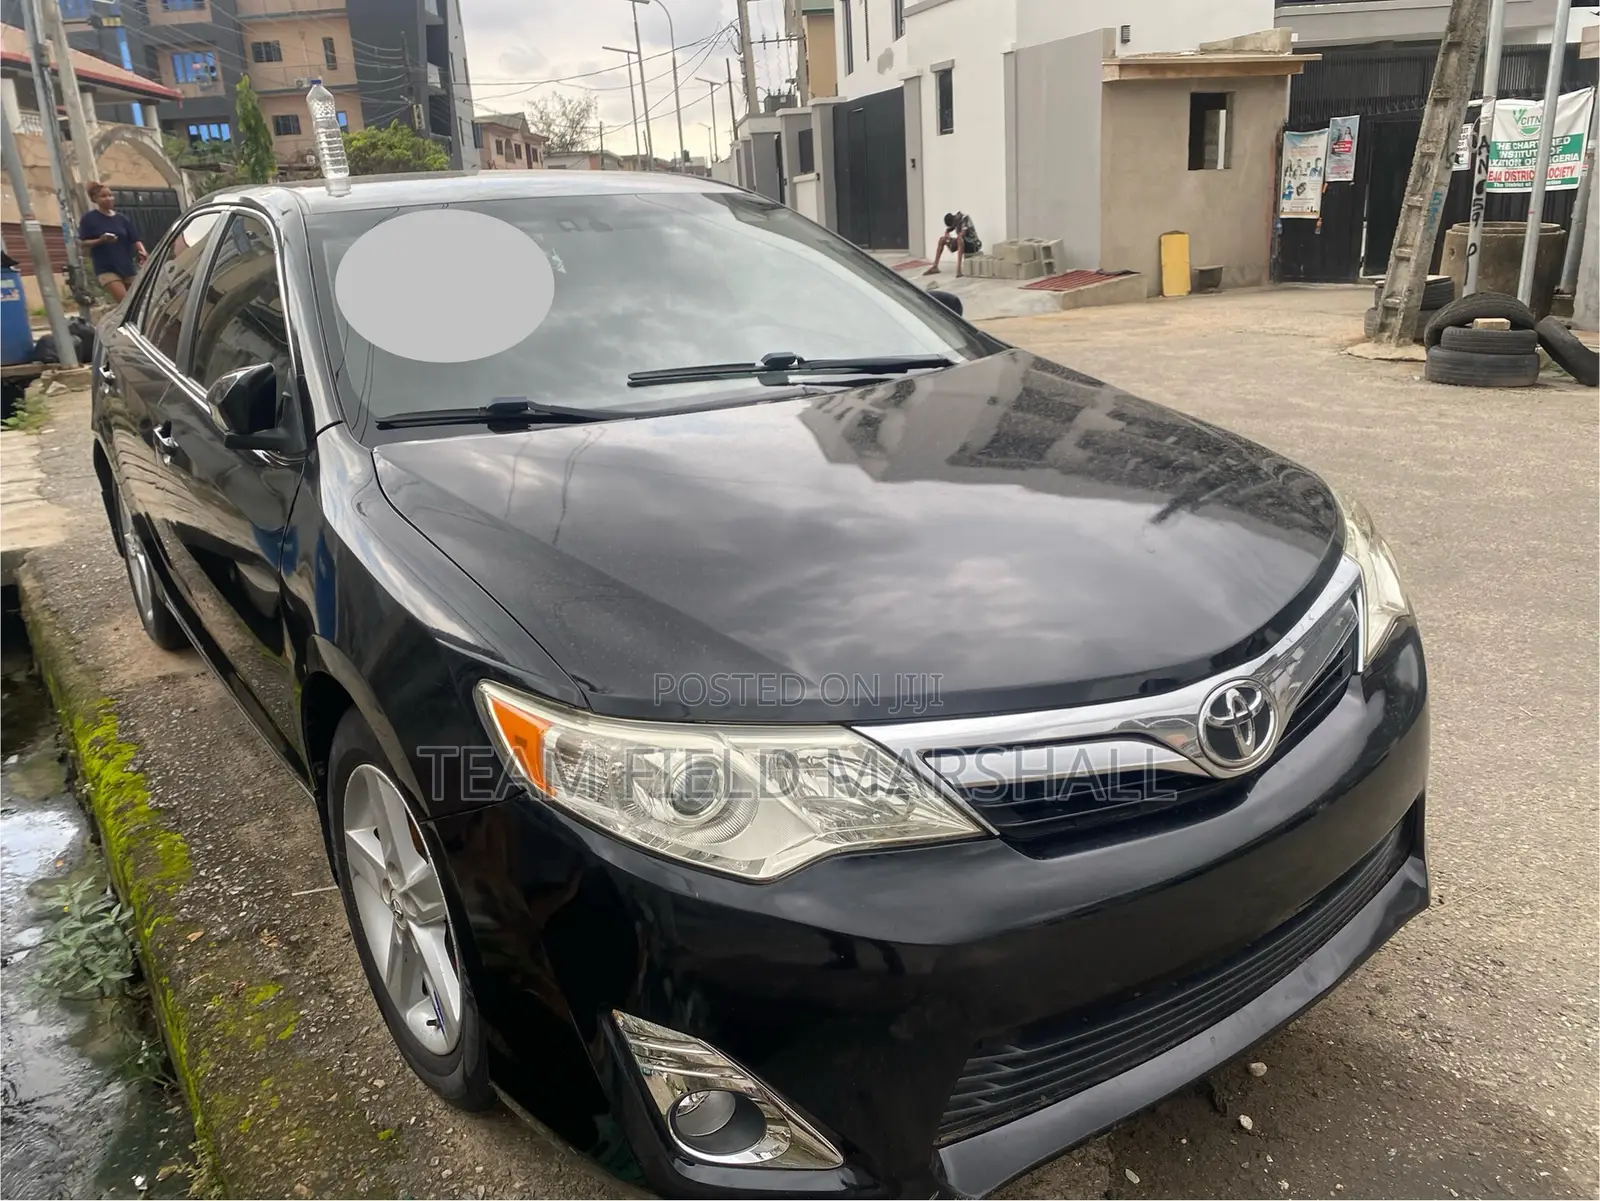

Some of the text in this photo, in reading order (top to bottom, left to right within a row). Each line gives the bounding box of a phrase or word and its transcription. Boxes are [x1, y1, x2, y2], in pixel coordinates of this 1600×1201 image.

[1520, 116, 1541, 126] CITN
[1496, 142, 1511, 150] THE
[1499, 149, 1538, 158] INSTITUT
[1549, 153, 1579, 163] IGERIA
[1504, 170, 1536, 181] DISTRIC
[1546, 165, 1576, 179] OCIETY
